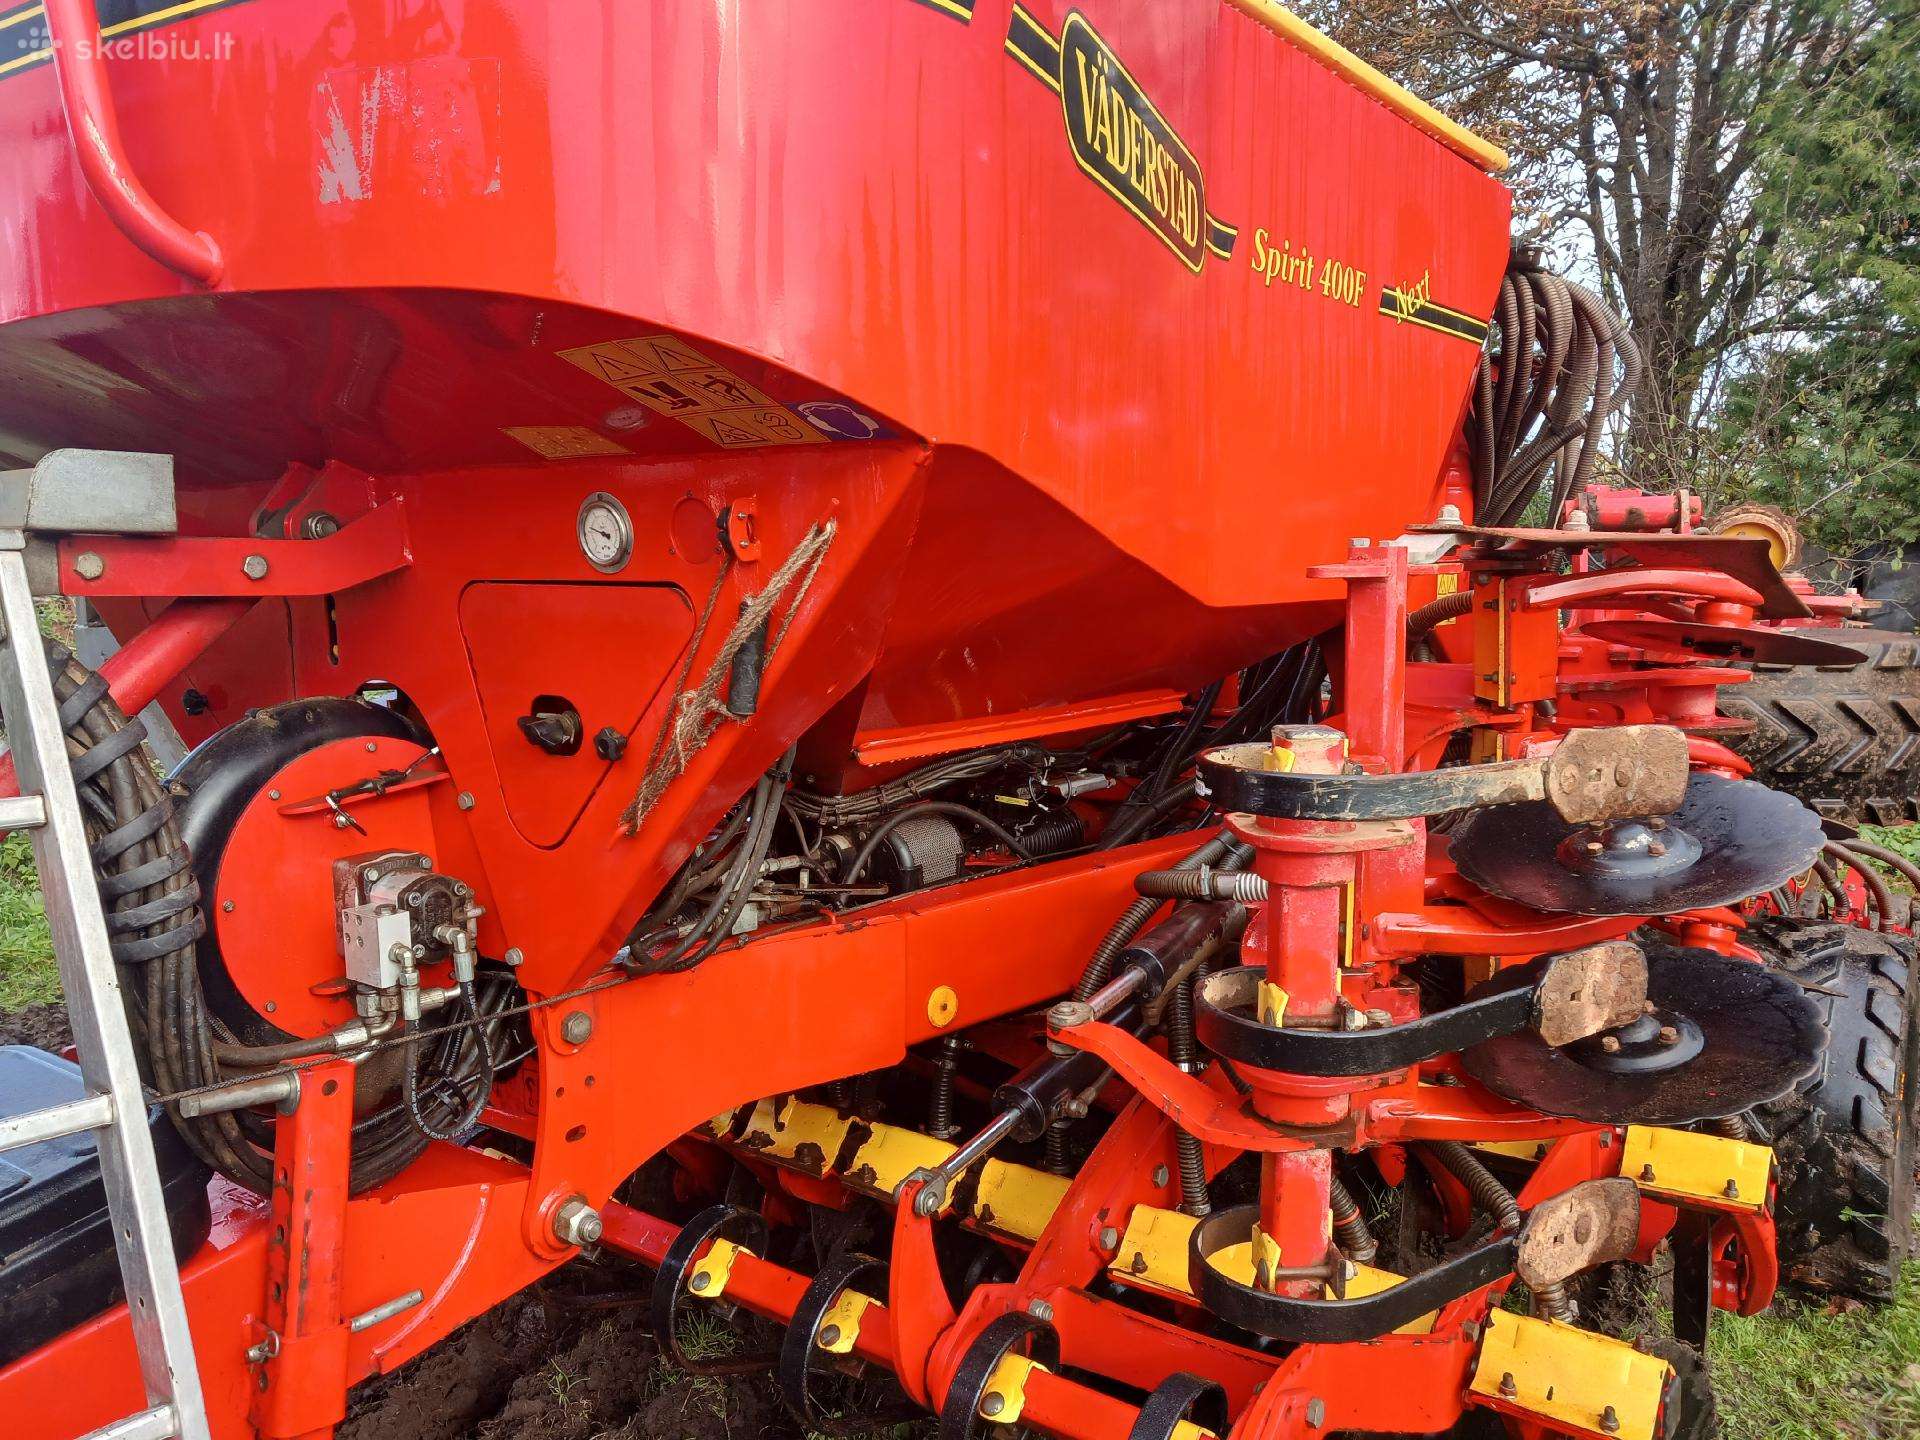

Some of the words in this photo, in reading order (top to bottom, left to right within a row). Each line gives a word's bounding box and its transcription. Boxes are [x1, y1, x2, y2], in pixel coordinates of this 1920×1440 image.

[1075, 46, 1199, 249] VÄDERSTAD
[1250, 227, 1315, 291] Spirit
[1318, 257, 1368, 308] 400F
[1395, 268, 1432, 325] Next
